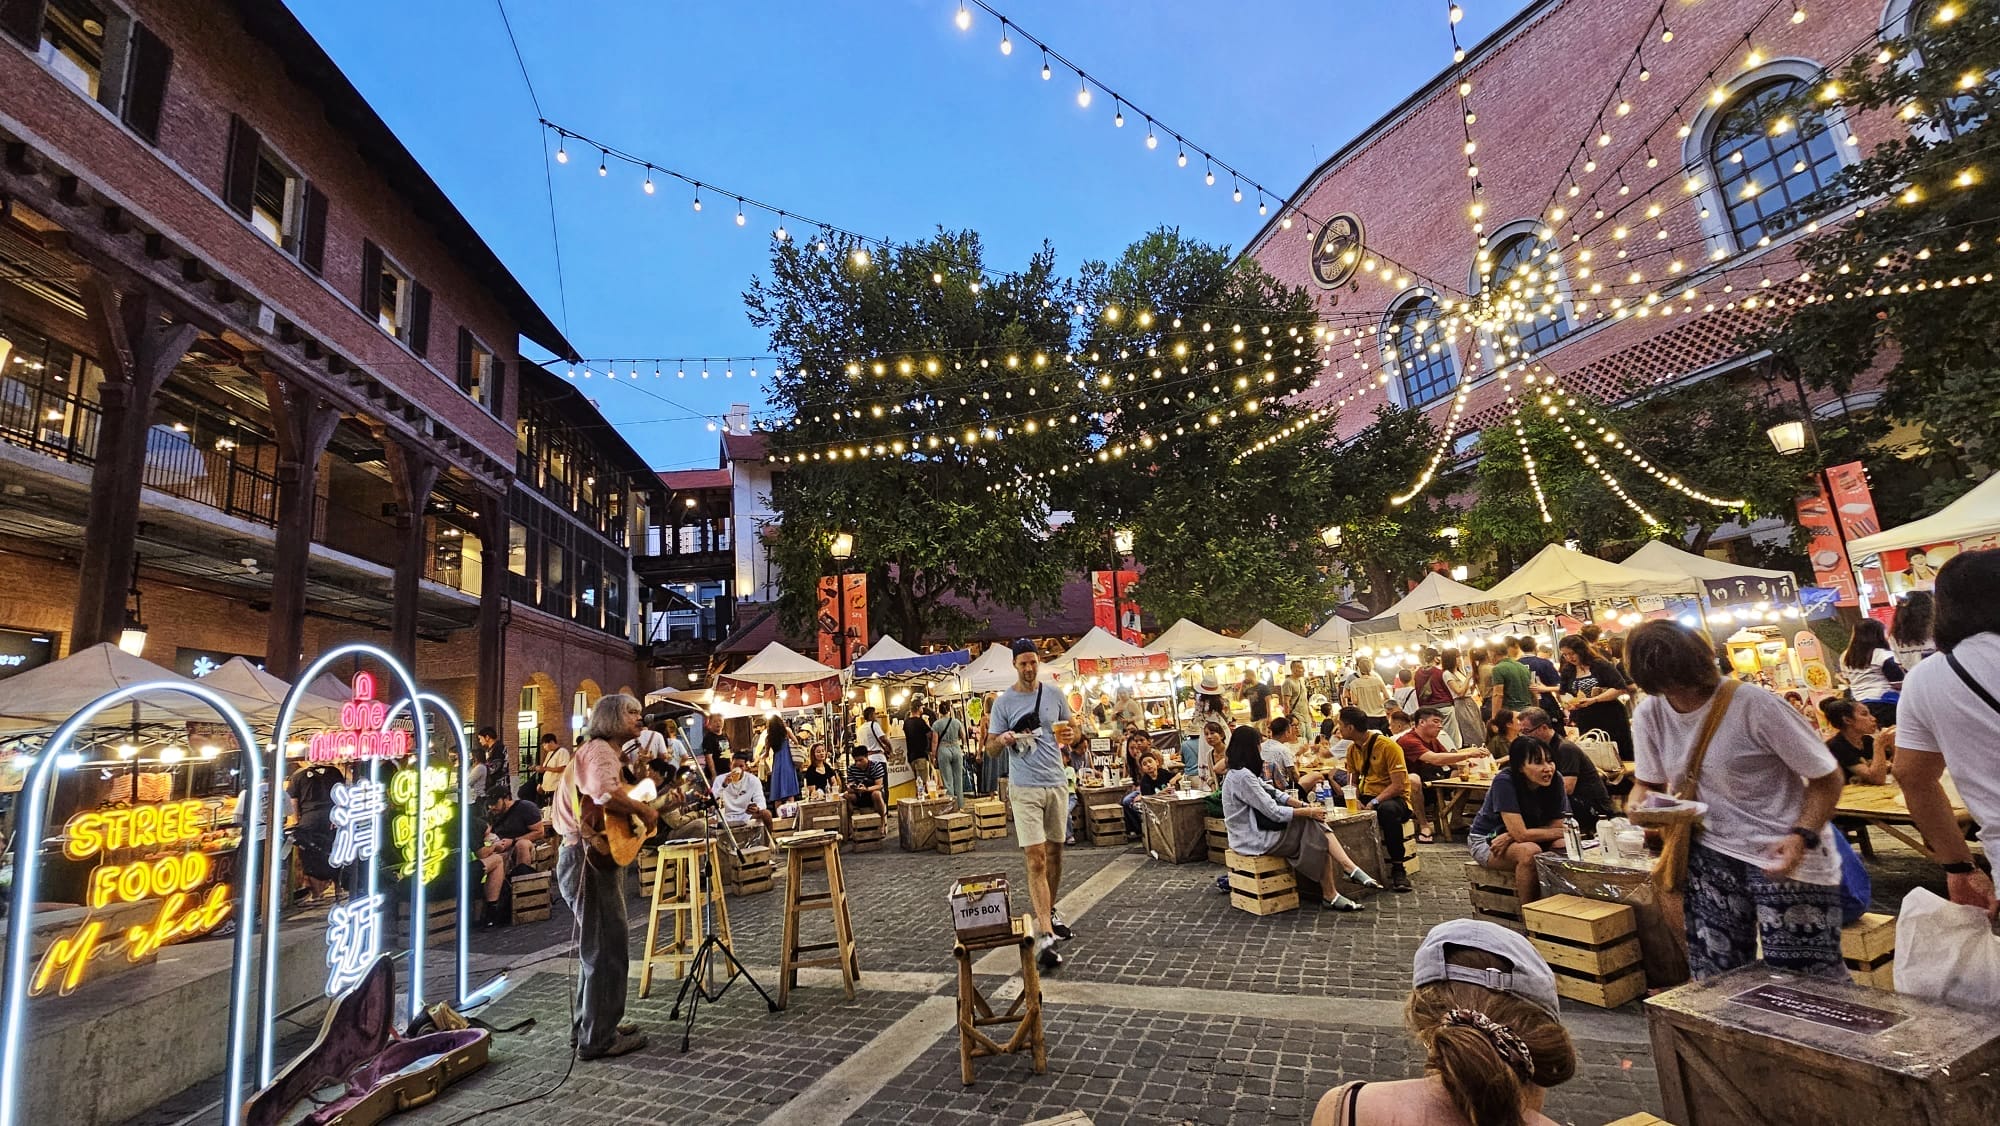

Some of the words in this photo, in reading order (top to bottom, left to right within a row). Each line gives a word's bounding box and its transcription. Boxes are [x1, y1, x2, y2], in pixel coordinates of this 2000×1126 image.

[1425, 608, 1449, 625] TAK
[1464, 600, 1500, 619] JUNG
[341, 701, 384, 731] one
[92, 852, 208, 909] FOOD
[960, 907, 980, 919] TIPS
[981, 904, 1001, 915] BOX
[30, 884, 231, 993] Market
